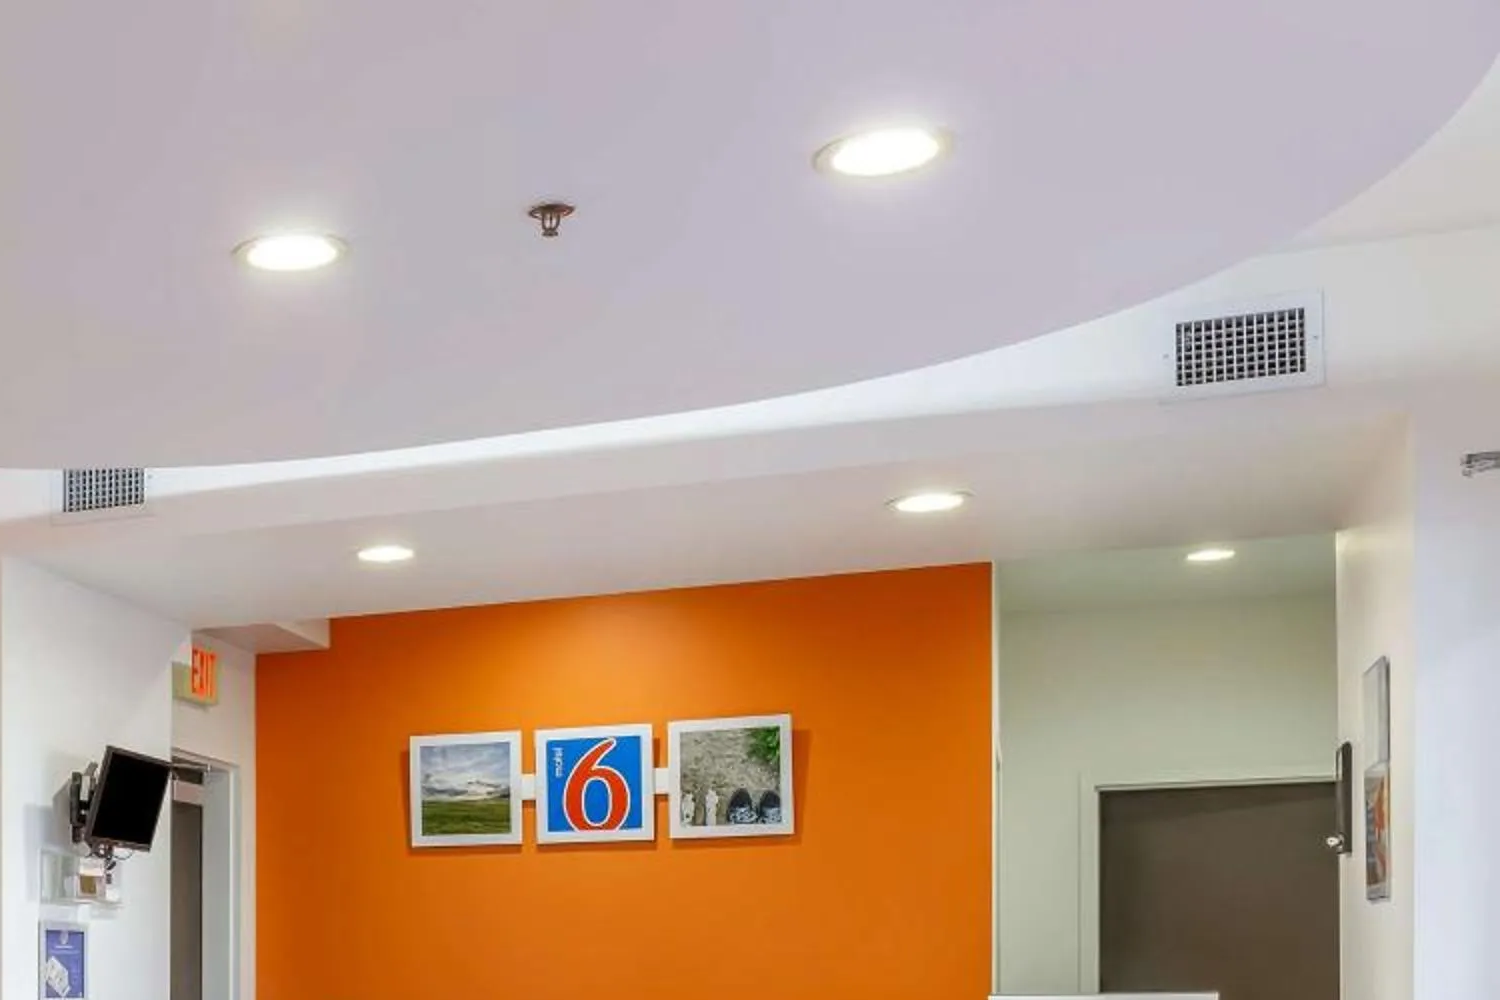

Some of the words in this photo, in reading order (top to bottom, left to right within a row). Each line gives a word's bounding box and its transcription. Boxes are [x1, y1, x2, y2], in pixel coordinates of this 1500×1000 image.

[191, 648, 217, 701] EXIT
[552, 747, 564, 778] motel
[563, 737, 631, 832] 6
